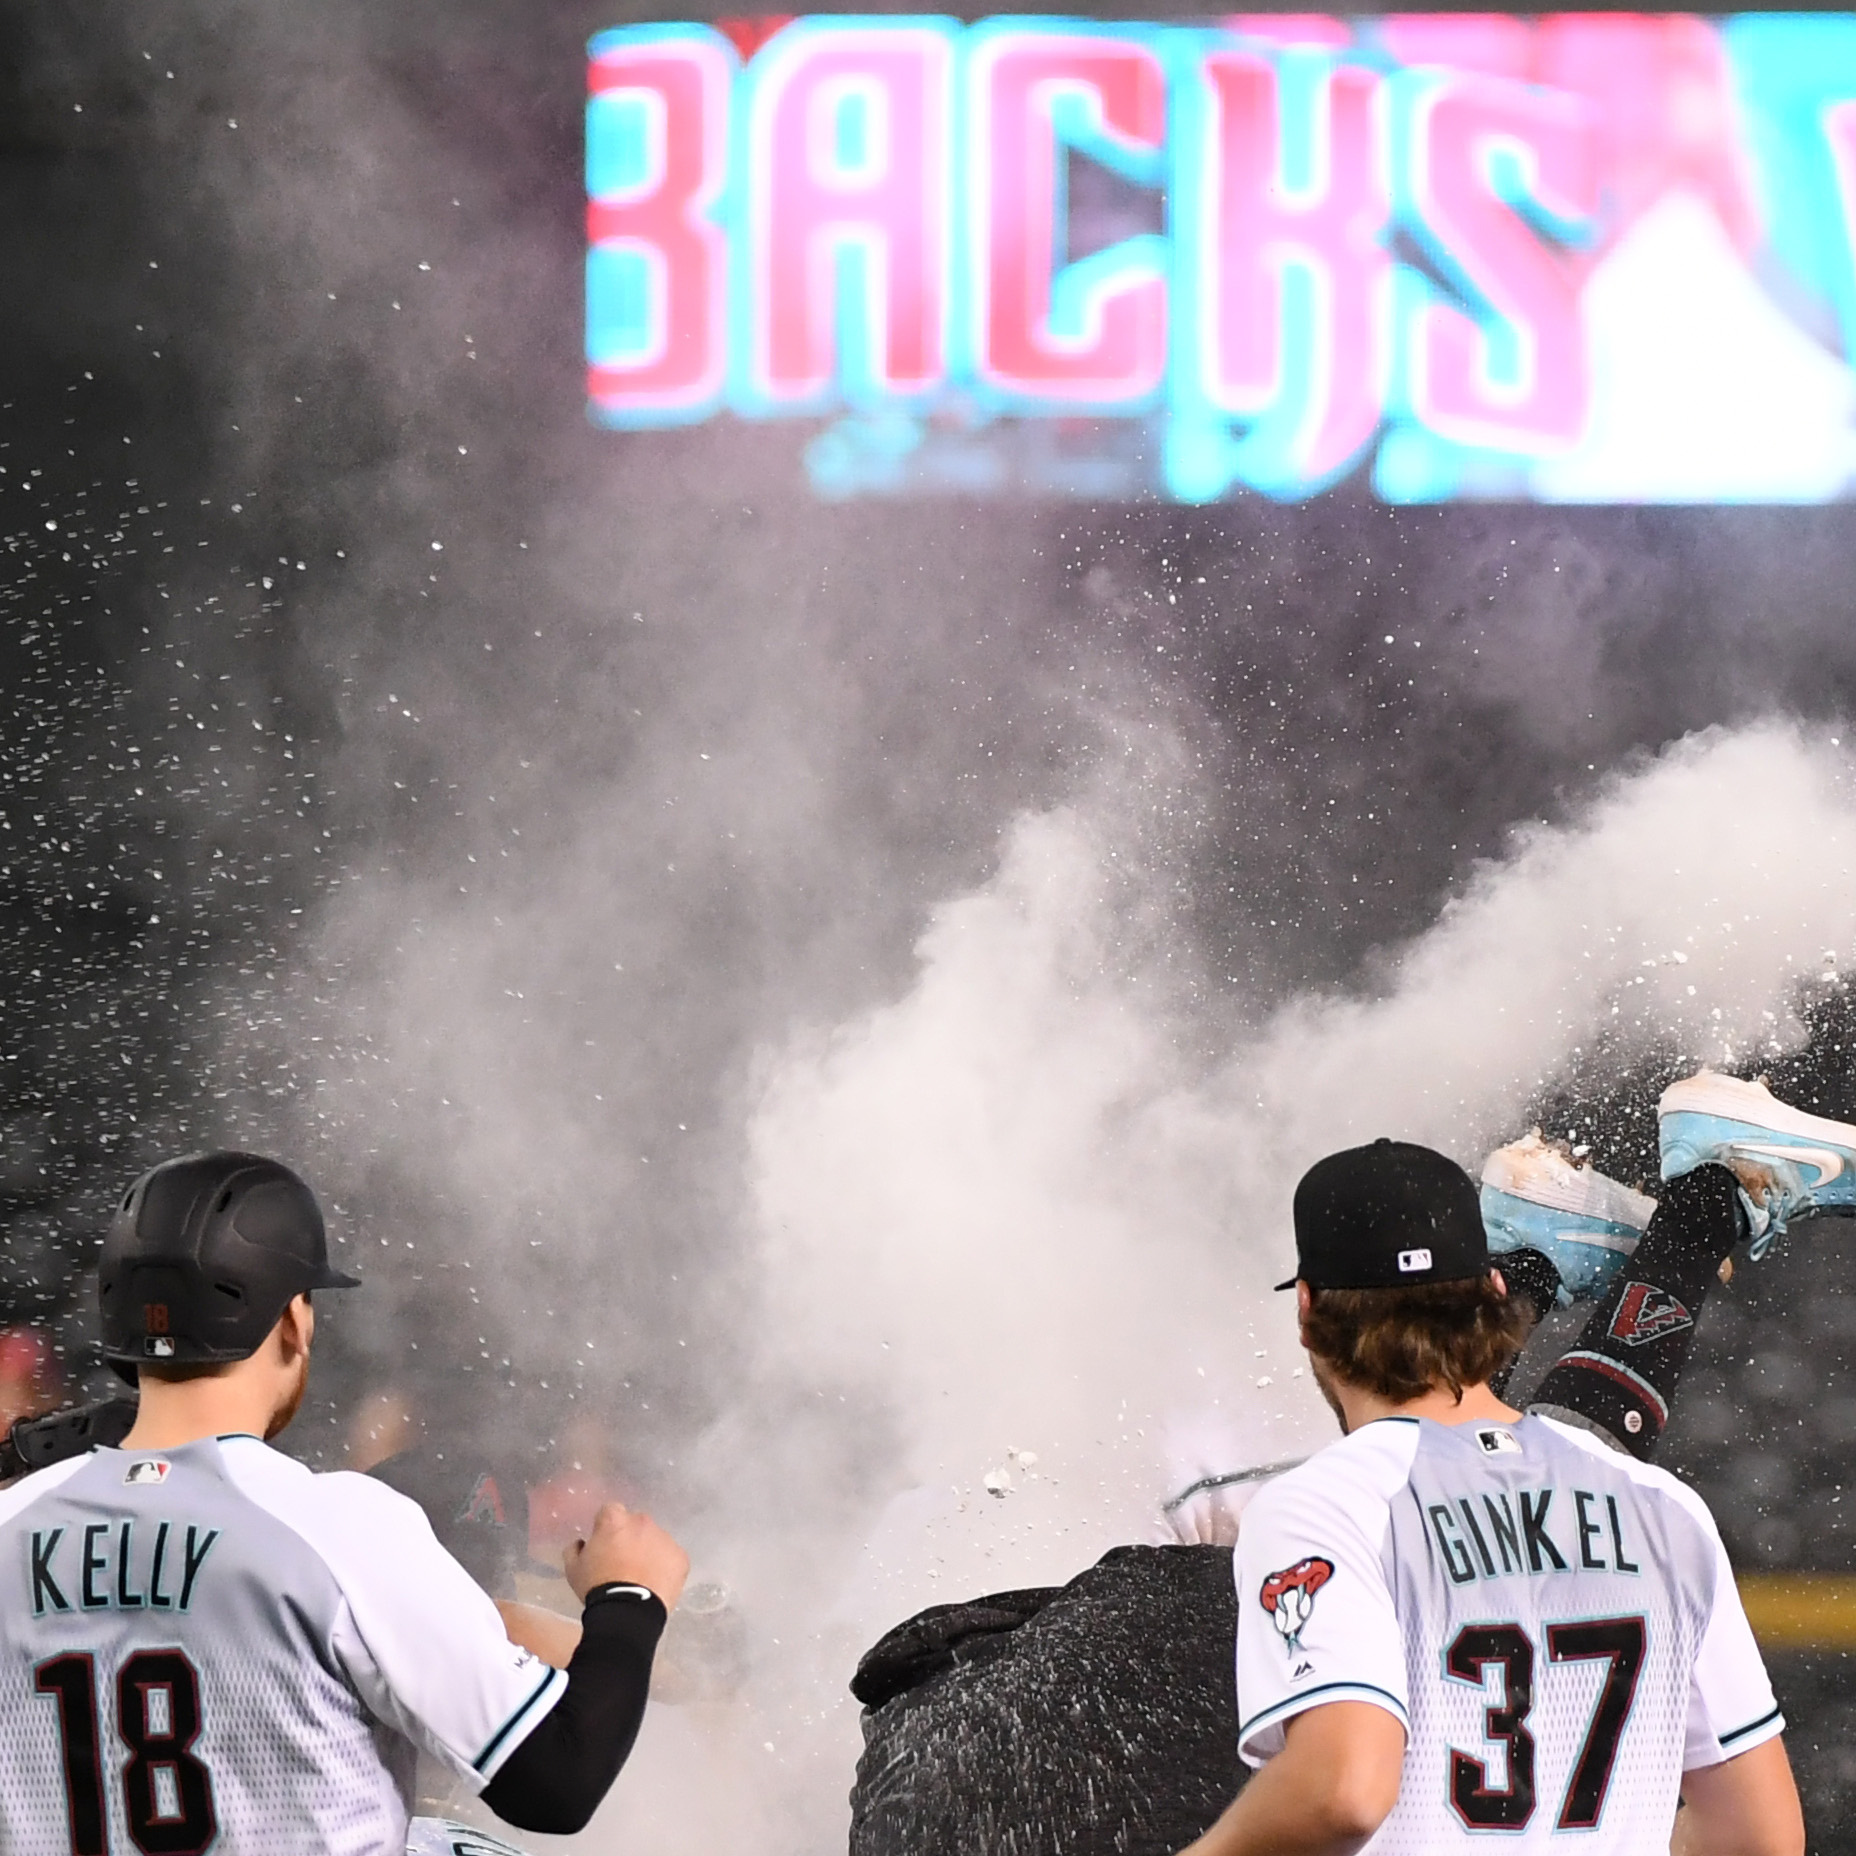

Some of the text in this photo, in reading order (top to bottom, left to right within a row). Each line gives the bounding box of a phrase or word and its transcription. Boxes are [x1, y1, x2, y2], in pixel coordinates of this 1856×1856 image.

[29, 1521, 221, 1618] KELLY
[1428, 1488, 1642, 1588] GINKEL
[1439, 1609, 1650, 1837] 37
